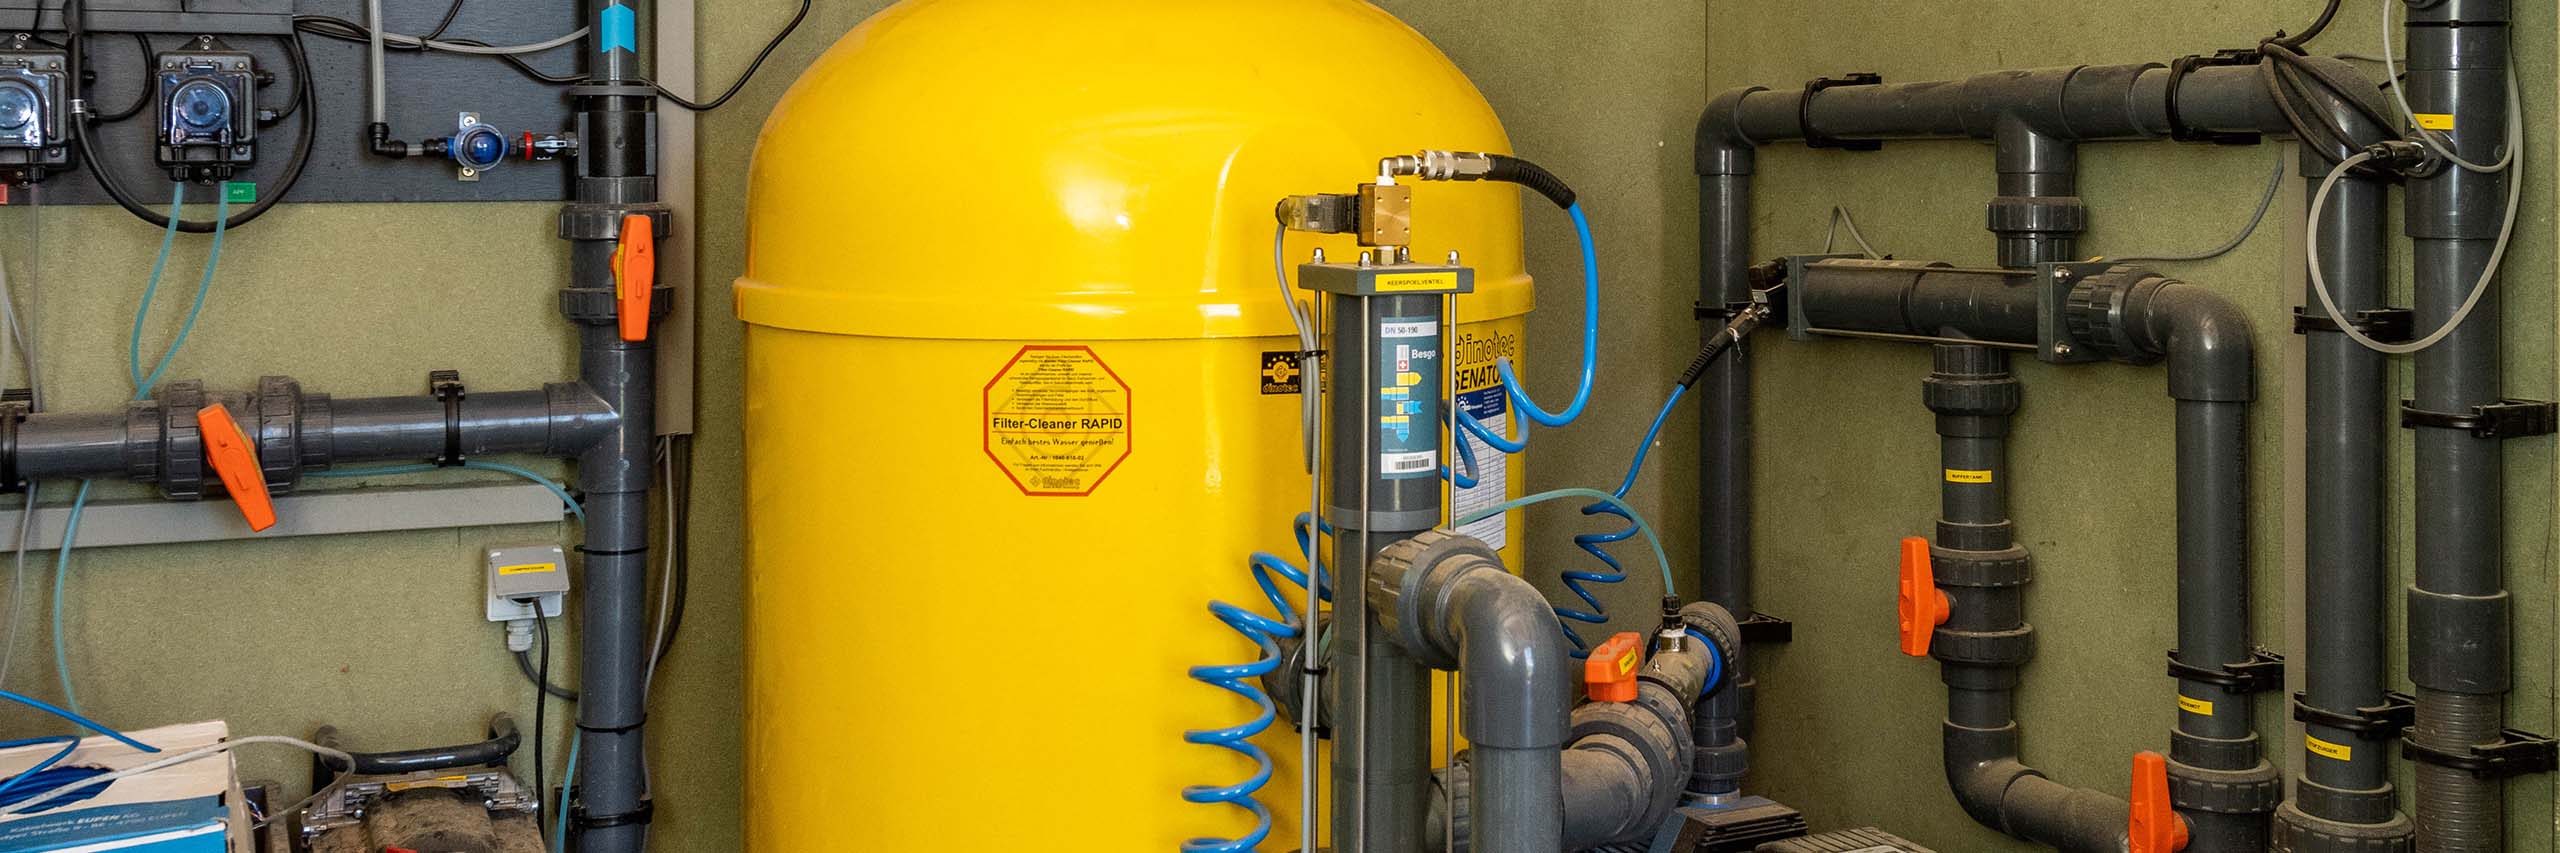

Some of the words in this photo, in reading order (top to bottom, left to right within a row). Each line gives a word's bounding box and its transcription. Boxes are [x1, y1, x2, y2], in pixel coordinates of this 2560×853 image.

[1385, 326, 1396, 334] DN
[1455, 329, 1515, 367] dinotec
[1411, 349, 1436, 360] Besgo
[1455, 362, 1511, 391] SENATO
[1263, 383, 1299, 393] dinotec
[992, 417, 1077, 429] Filter-Cleaner
[1081, 418, 1123, 429] RAPID
[1001, 437, 1027, 446] Einfach
[1028, 438, 1051, 446] bestes
[1052, 438, 1078, 446] Wasser
[1080, 438, 1114, 447] genießen!
[77, 814, 121, 824] EUPEN
[31, 827, 70, 838] Straße
